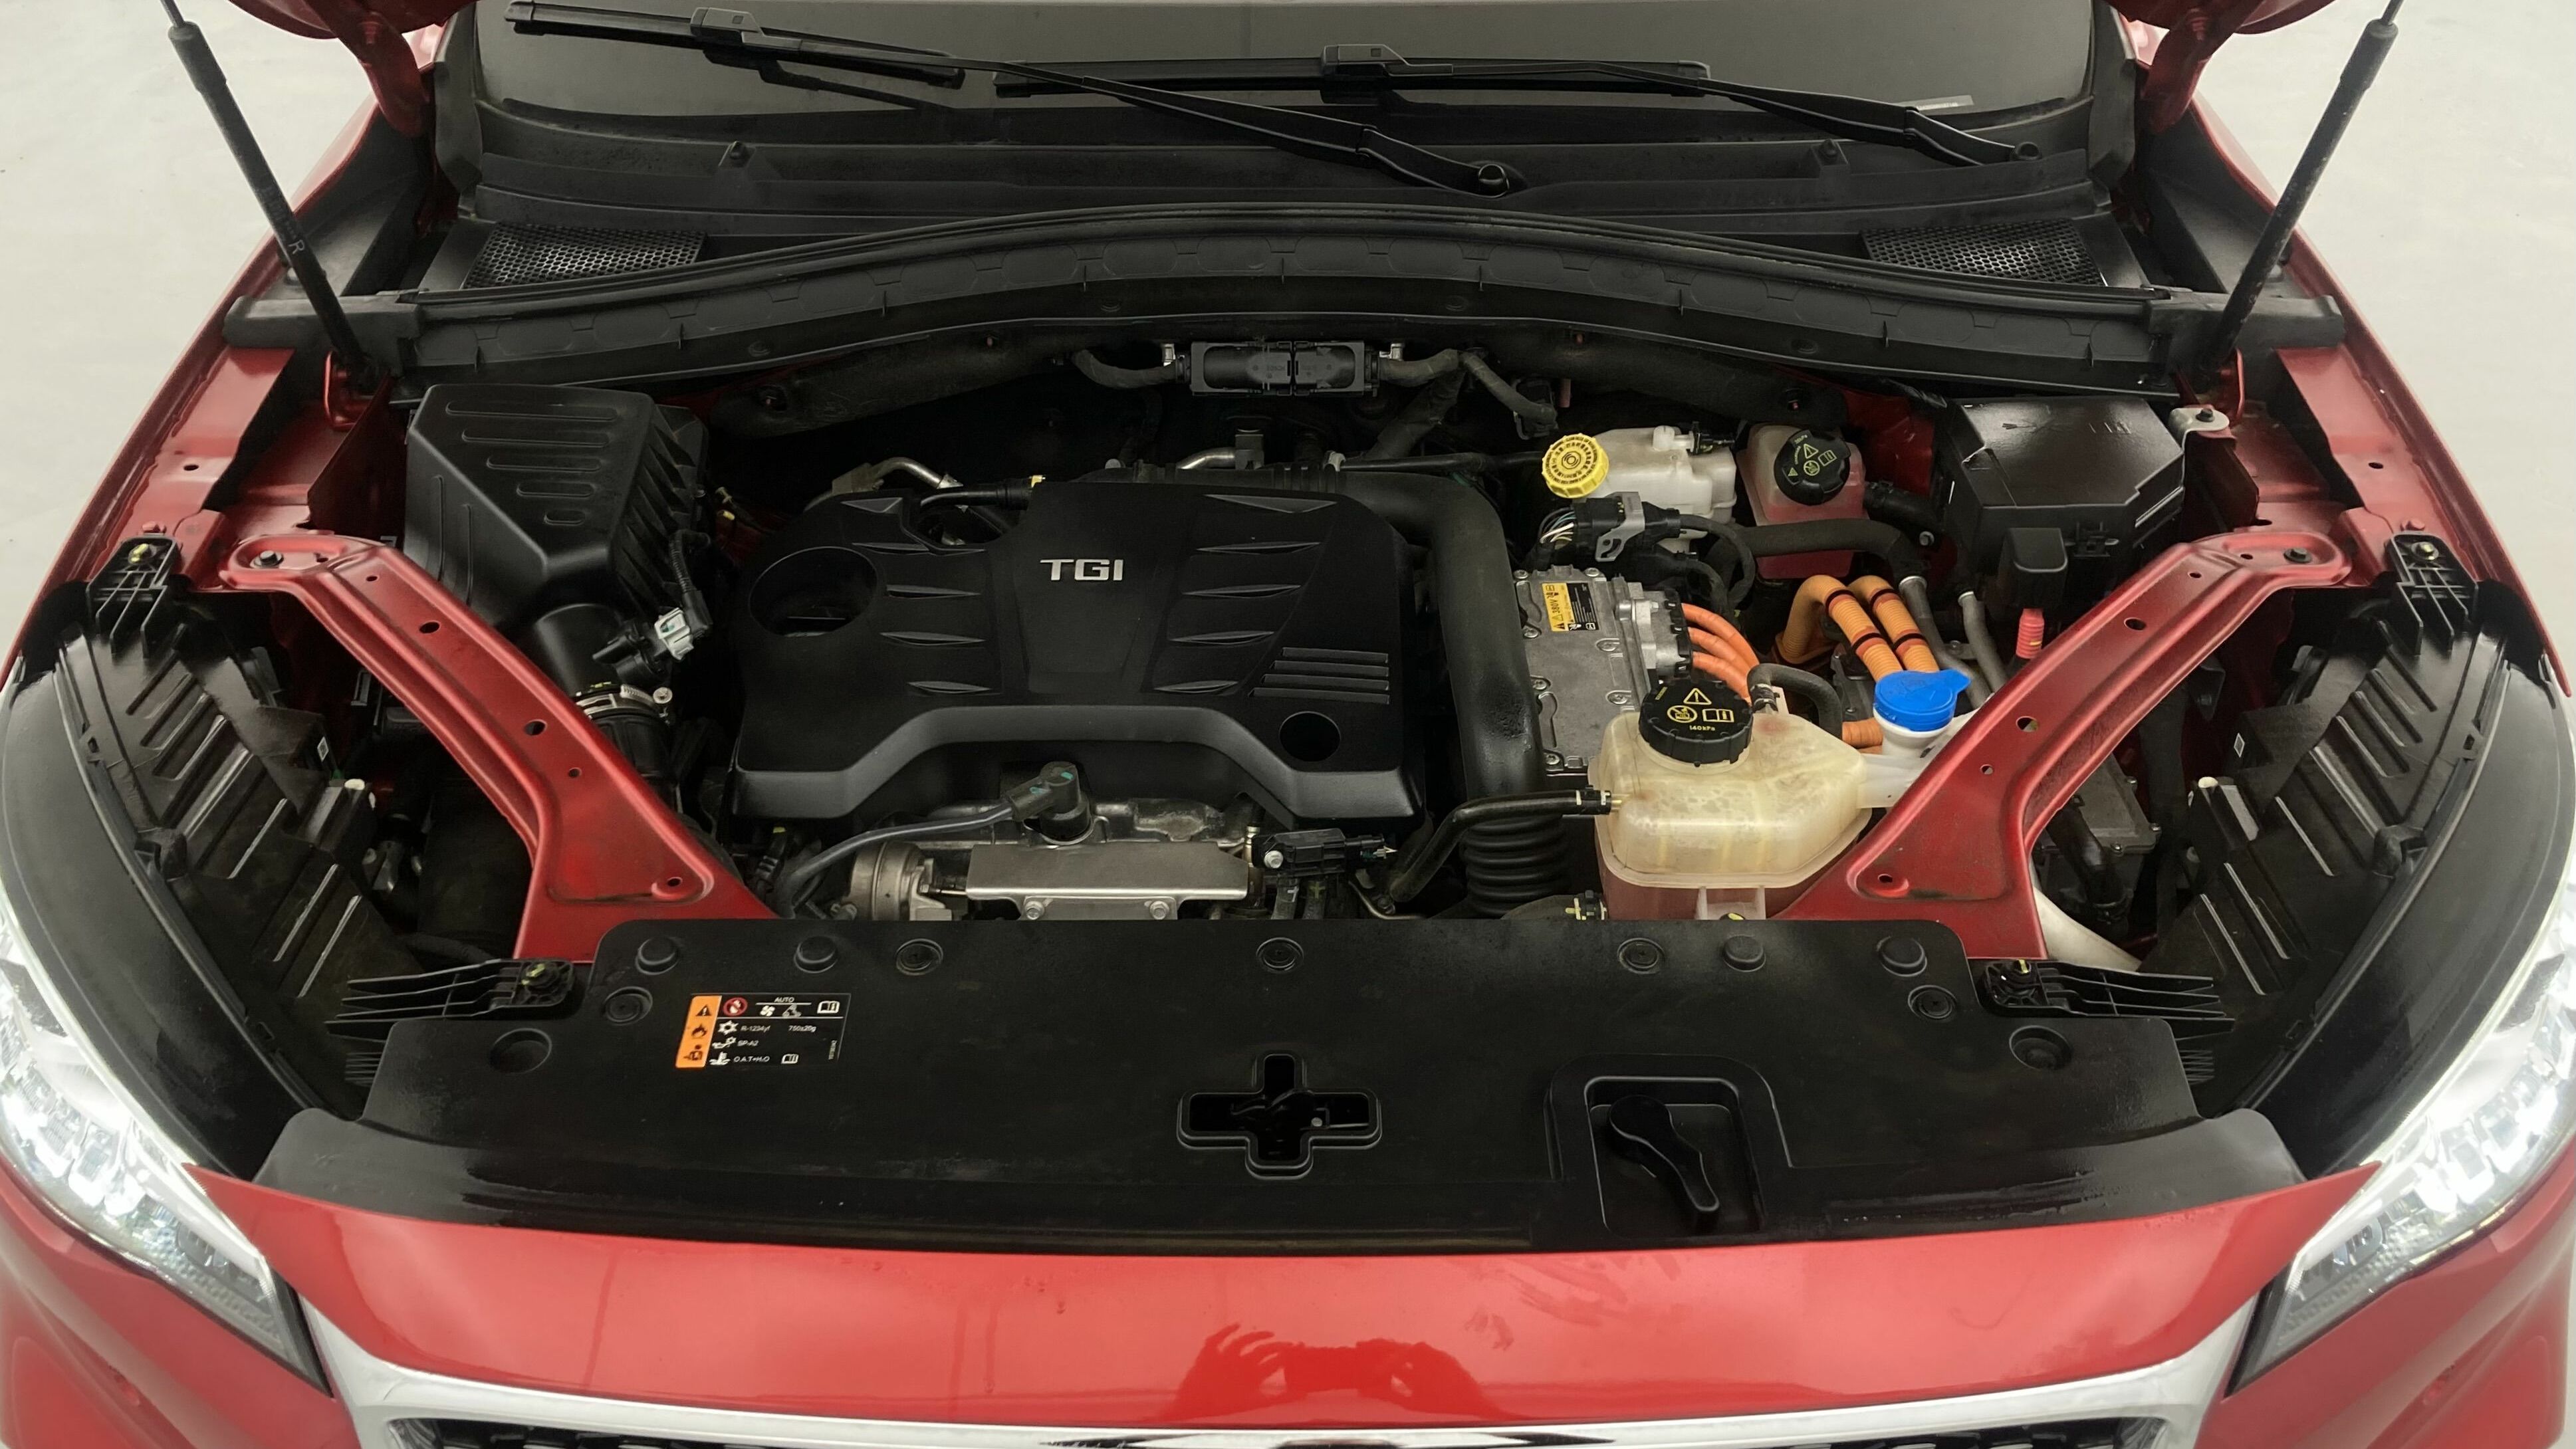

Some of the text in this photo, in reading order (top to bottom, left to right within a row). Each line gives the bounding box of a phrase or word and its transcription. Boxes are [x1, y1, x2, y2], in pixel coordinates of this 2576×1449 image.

[288, 239, 305, 255] R
[1040, 559, 1123, 581] TGI
[1550, 599, 1560, 613] 380V
